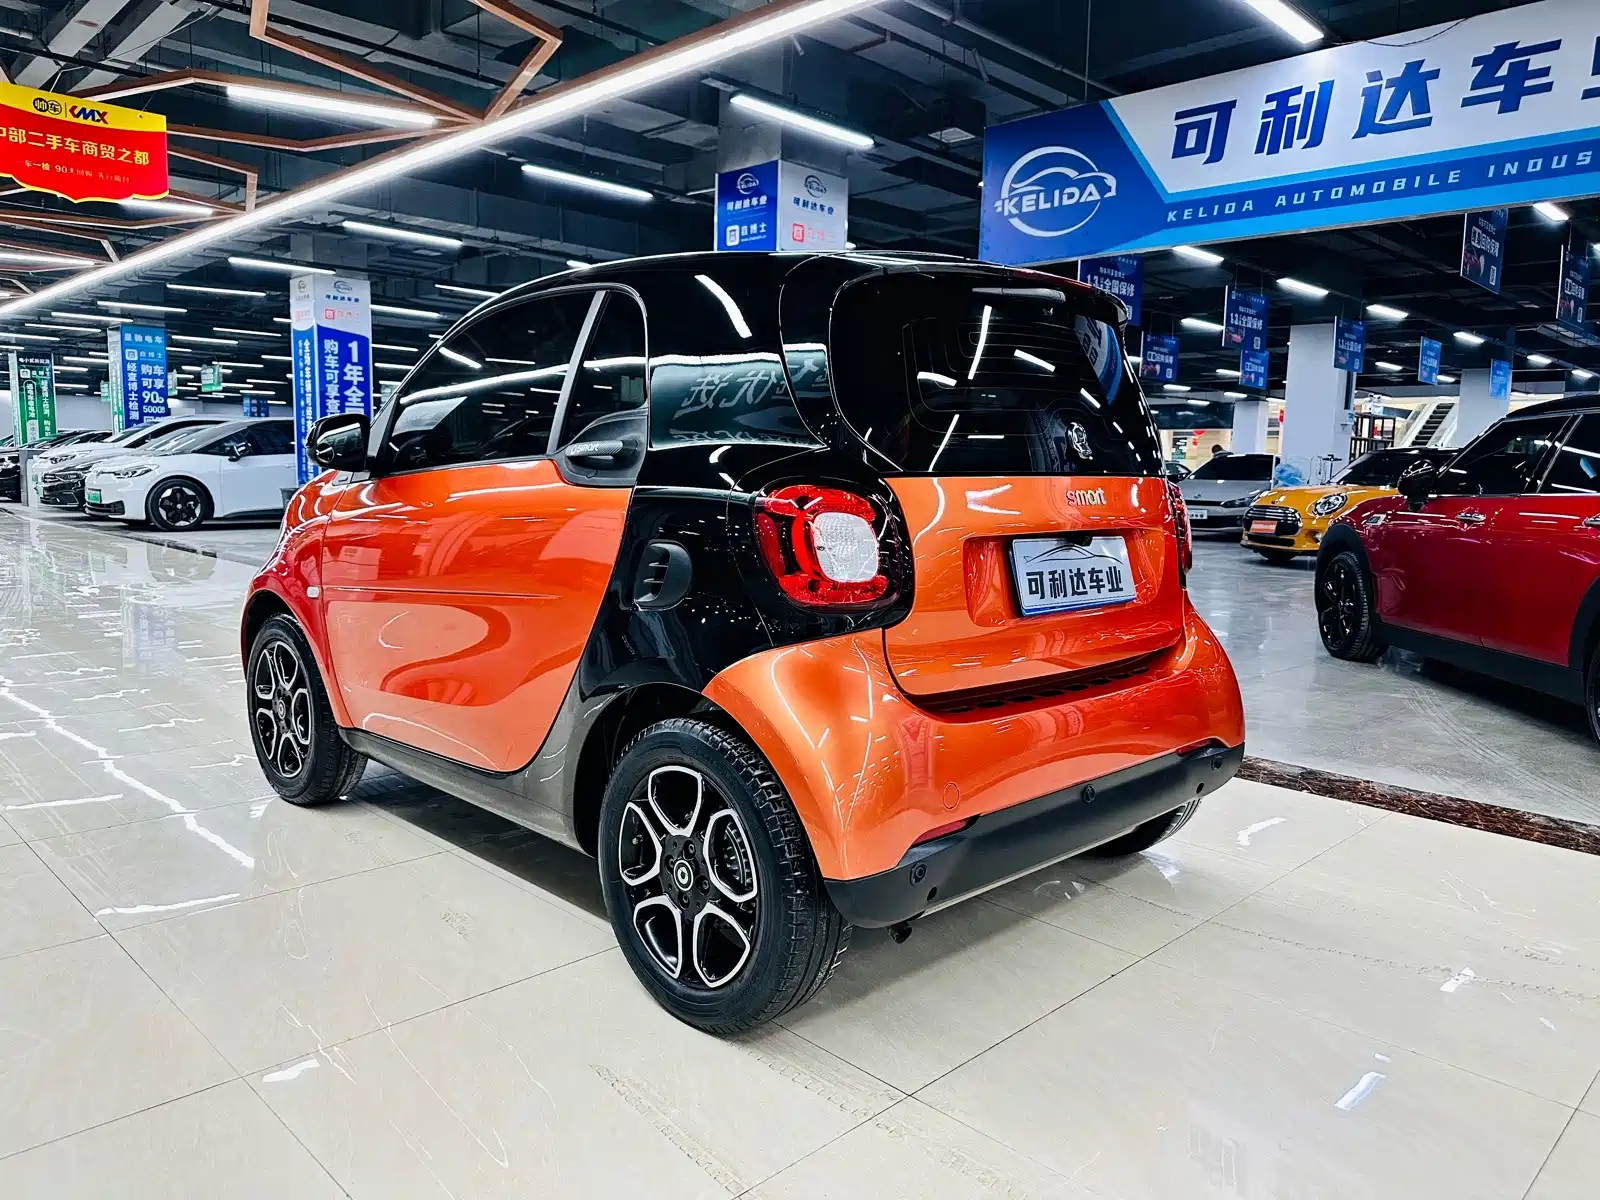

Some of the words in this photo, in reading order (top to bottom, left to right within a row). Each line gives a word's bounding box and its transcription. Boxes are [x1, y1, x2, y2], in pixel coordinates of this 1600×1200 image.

[1171, 36, 1600, 165] 可利达车
[1003, 182, 1102, 216] KELIDA
[1167, 199, 1254, 223] KELIDA
[1275, 169, 1462, 208] AUTOMOBILE
[1487, 150, 1594, 178] INDUS
[140, 364, 165, 376] 购车
[141, 378, 166, 390] 可享
[576, 442, 600, 453] smart
[1066, 487, 1107, 507] smart
[1025, 565, 1124, 600] 可利达车业
